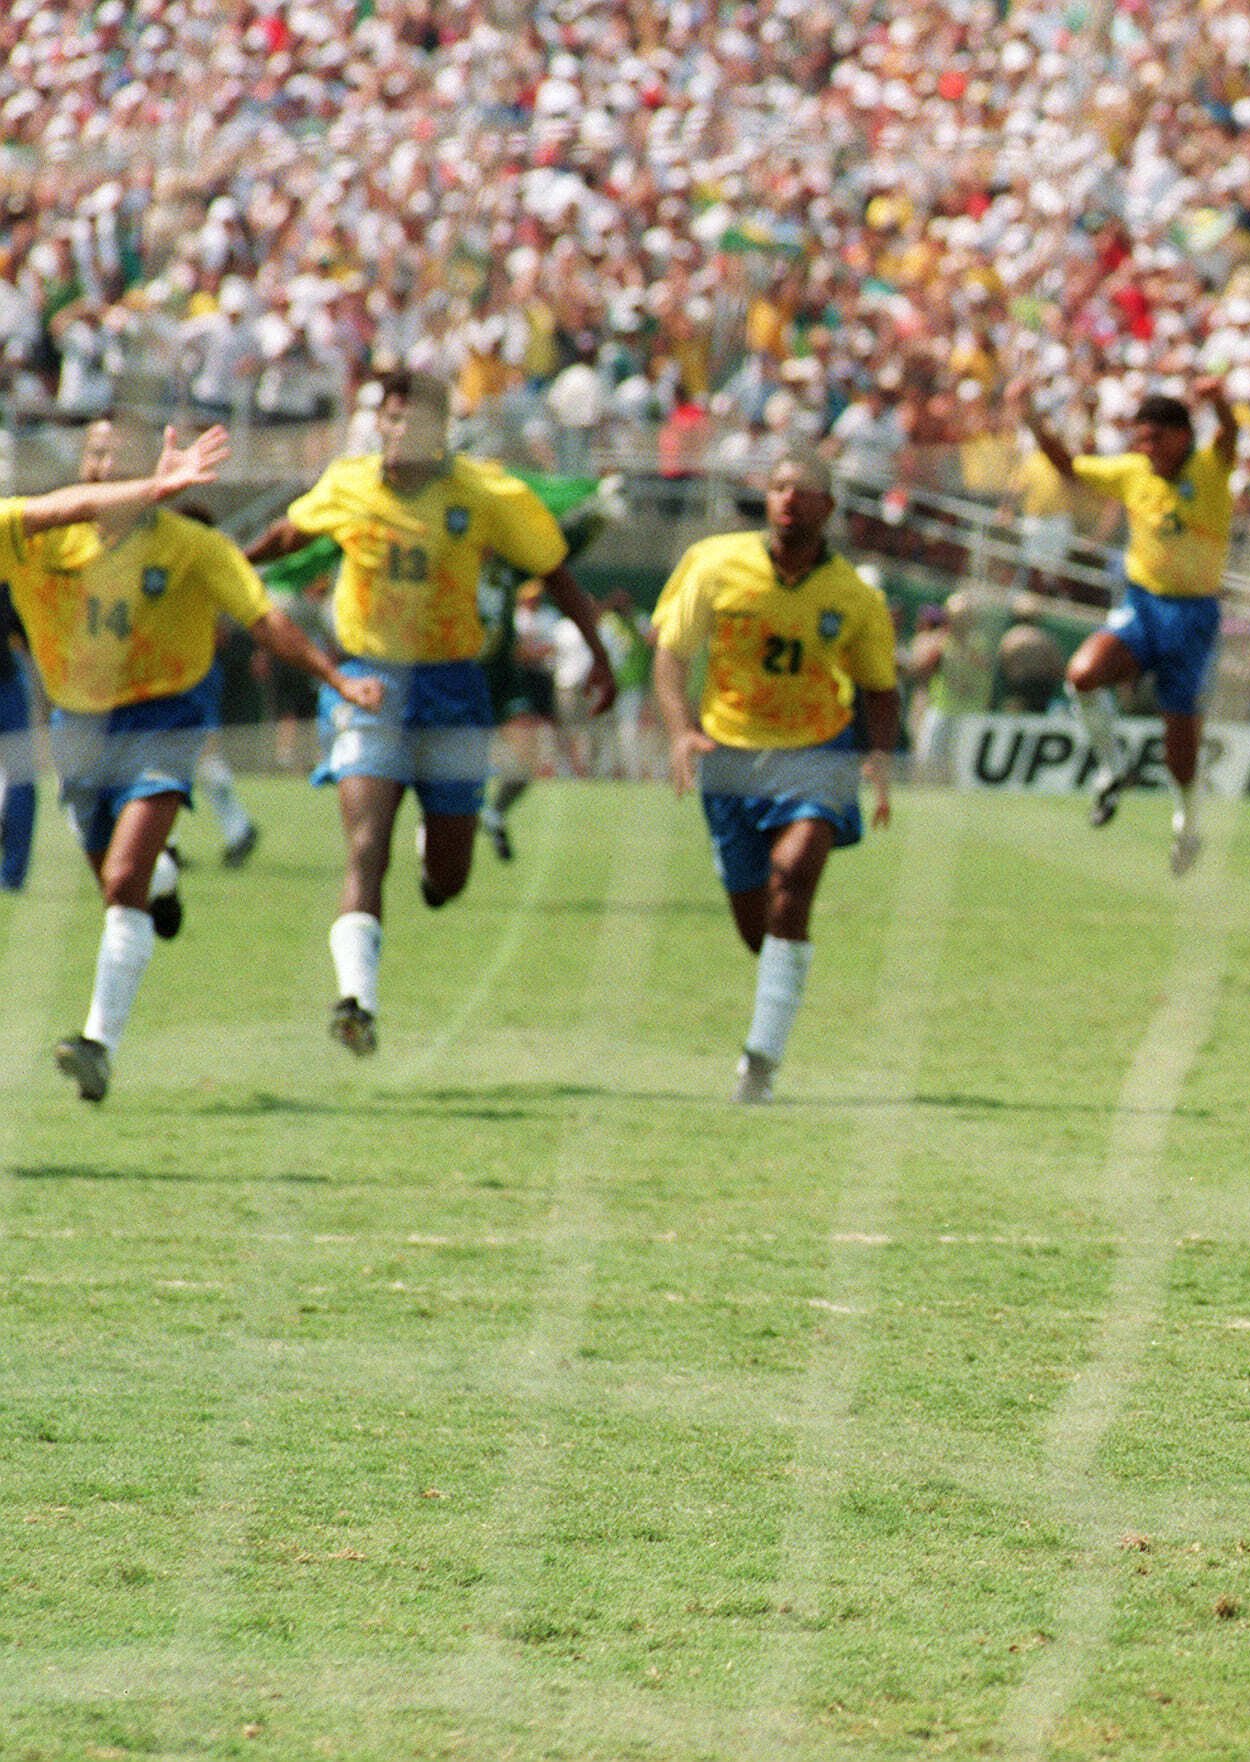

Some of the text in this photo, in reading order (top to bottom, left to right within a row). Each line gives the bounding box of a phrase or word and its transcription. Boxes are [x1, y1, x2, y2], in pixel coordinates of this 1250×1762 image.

[388, 542, 428, 583] 13
[86, 596, 133, 640] 14
[762, 634, 804, 676] 21
